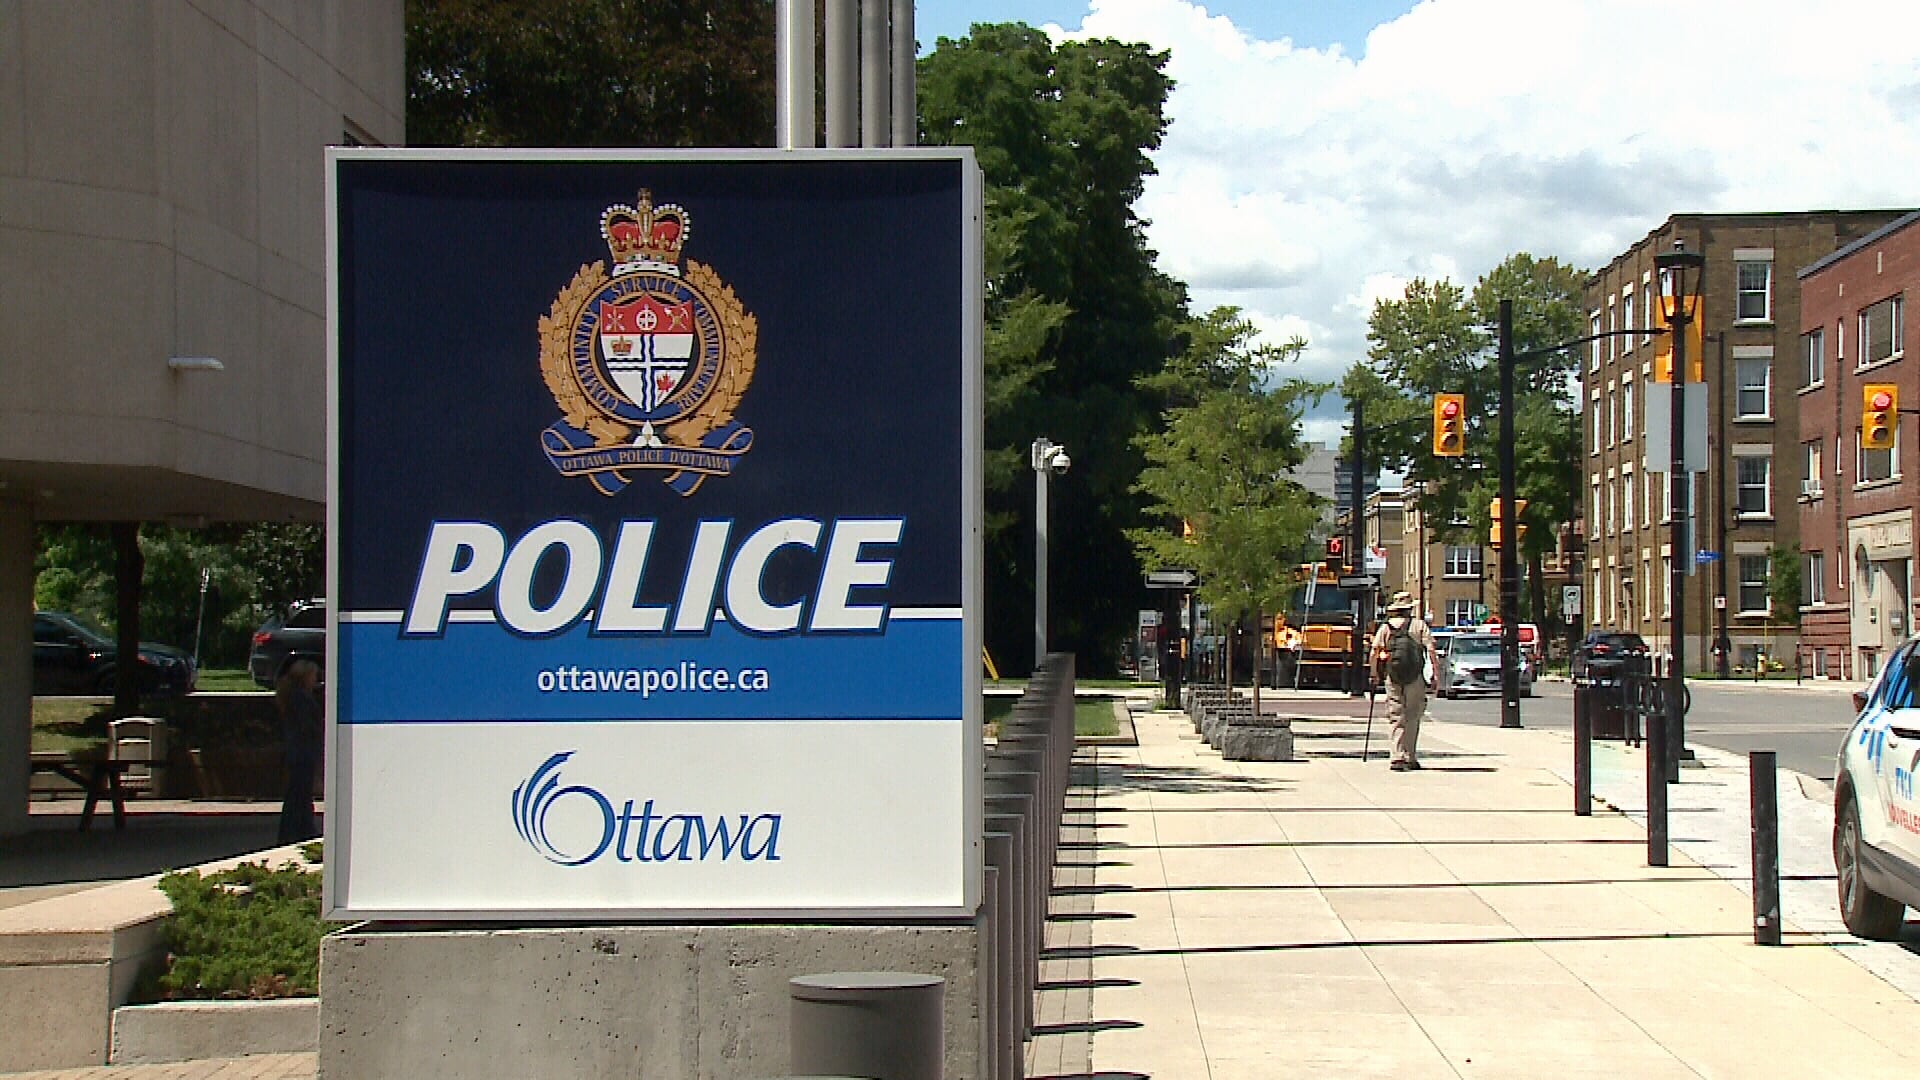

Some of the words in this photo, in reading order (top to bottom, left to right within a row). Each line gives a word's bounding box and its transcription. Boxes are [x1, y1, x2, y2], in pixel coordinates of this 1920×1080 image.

[613, 277, 681, 295] SERVICE
[562, 453, 613, 471] OTTAWA
[619, 450, 663, 463] POLICE
[670, 451, 731, 471] D'OTTAWA
[401, 517, 905, 637] POLICE
[537, 661, 770, 699] ottawapolice.ca
[511, 750, 783, 867] Ottawa
